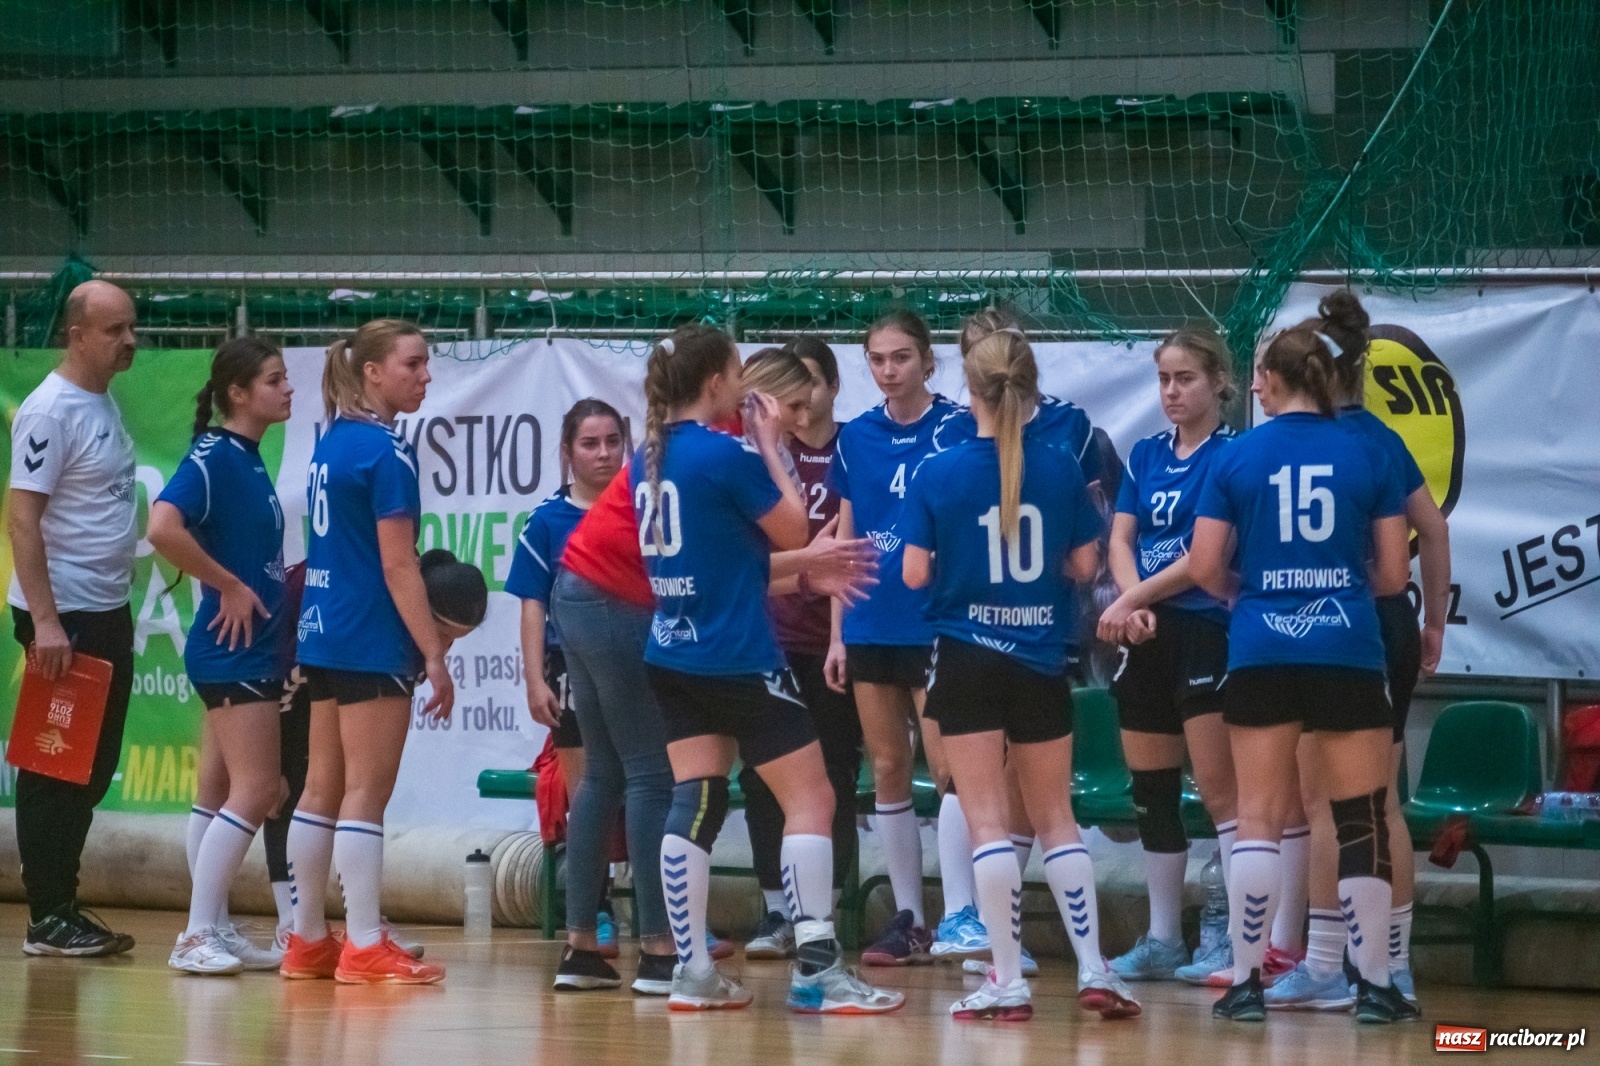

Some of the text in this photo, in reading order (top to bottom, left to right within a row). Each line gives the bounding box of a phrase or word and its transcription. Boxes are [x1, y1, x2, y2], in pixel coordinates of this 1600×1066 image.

[889, 463, 907, 499] 4
[635, 480, 682, 557] 20
[801, 482, 828, 520] 2
[1150, 490, 1182, 526] 27
[1269, 464, 1336, 544] 15
[978, 503, 1045, 584] 10
[1263, 567, 1352, 590] PIETROWICE
[968, 603, 1055, 627] PIETROWICE
[474, 647, 526, 687] pasj
[47, 711, 72, 725] EURO
[49, 702, 73, 717] 2016
[462, 697, 520, 731] roku.
